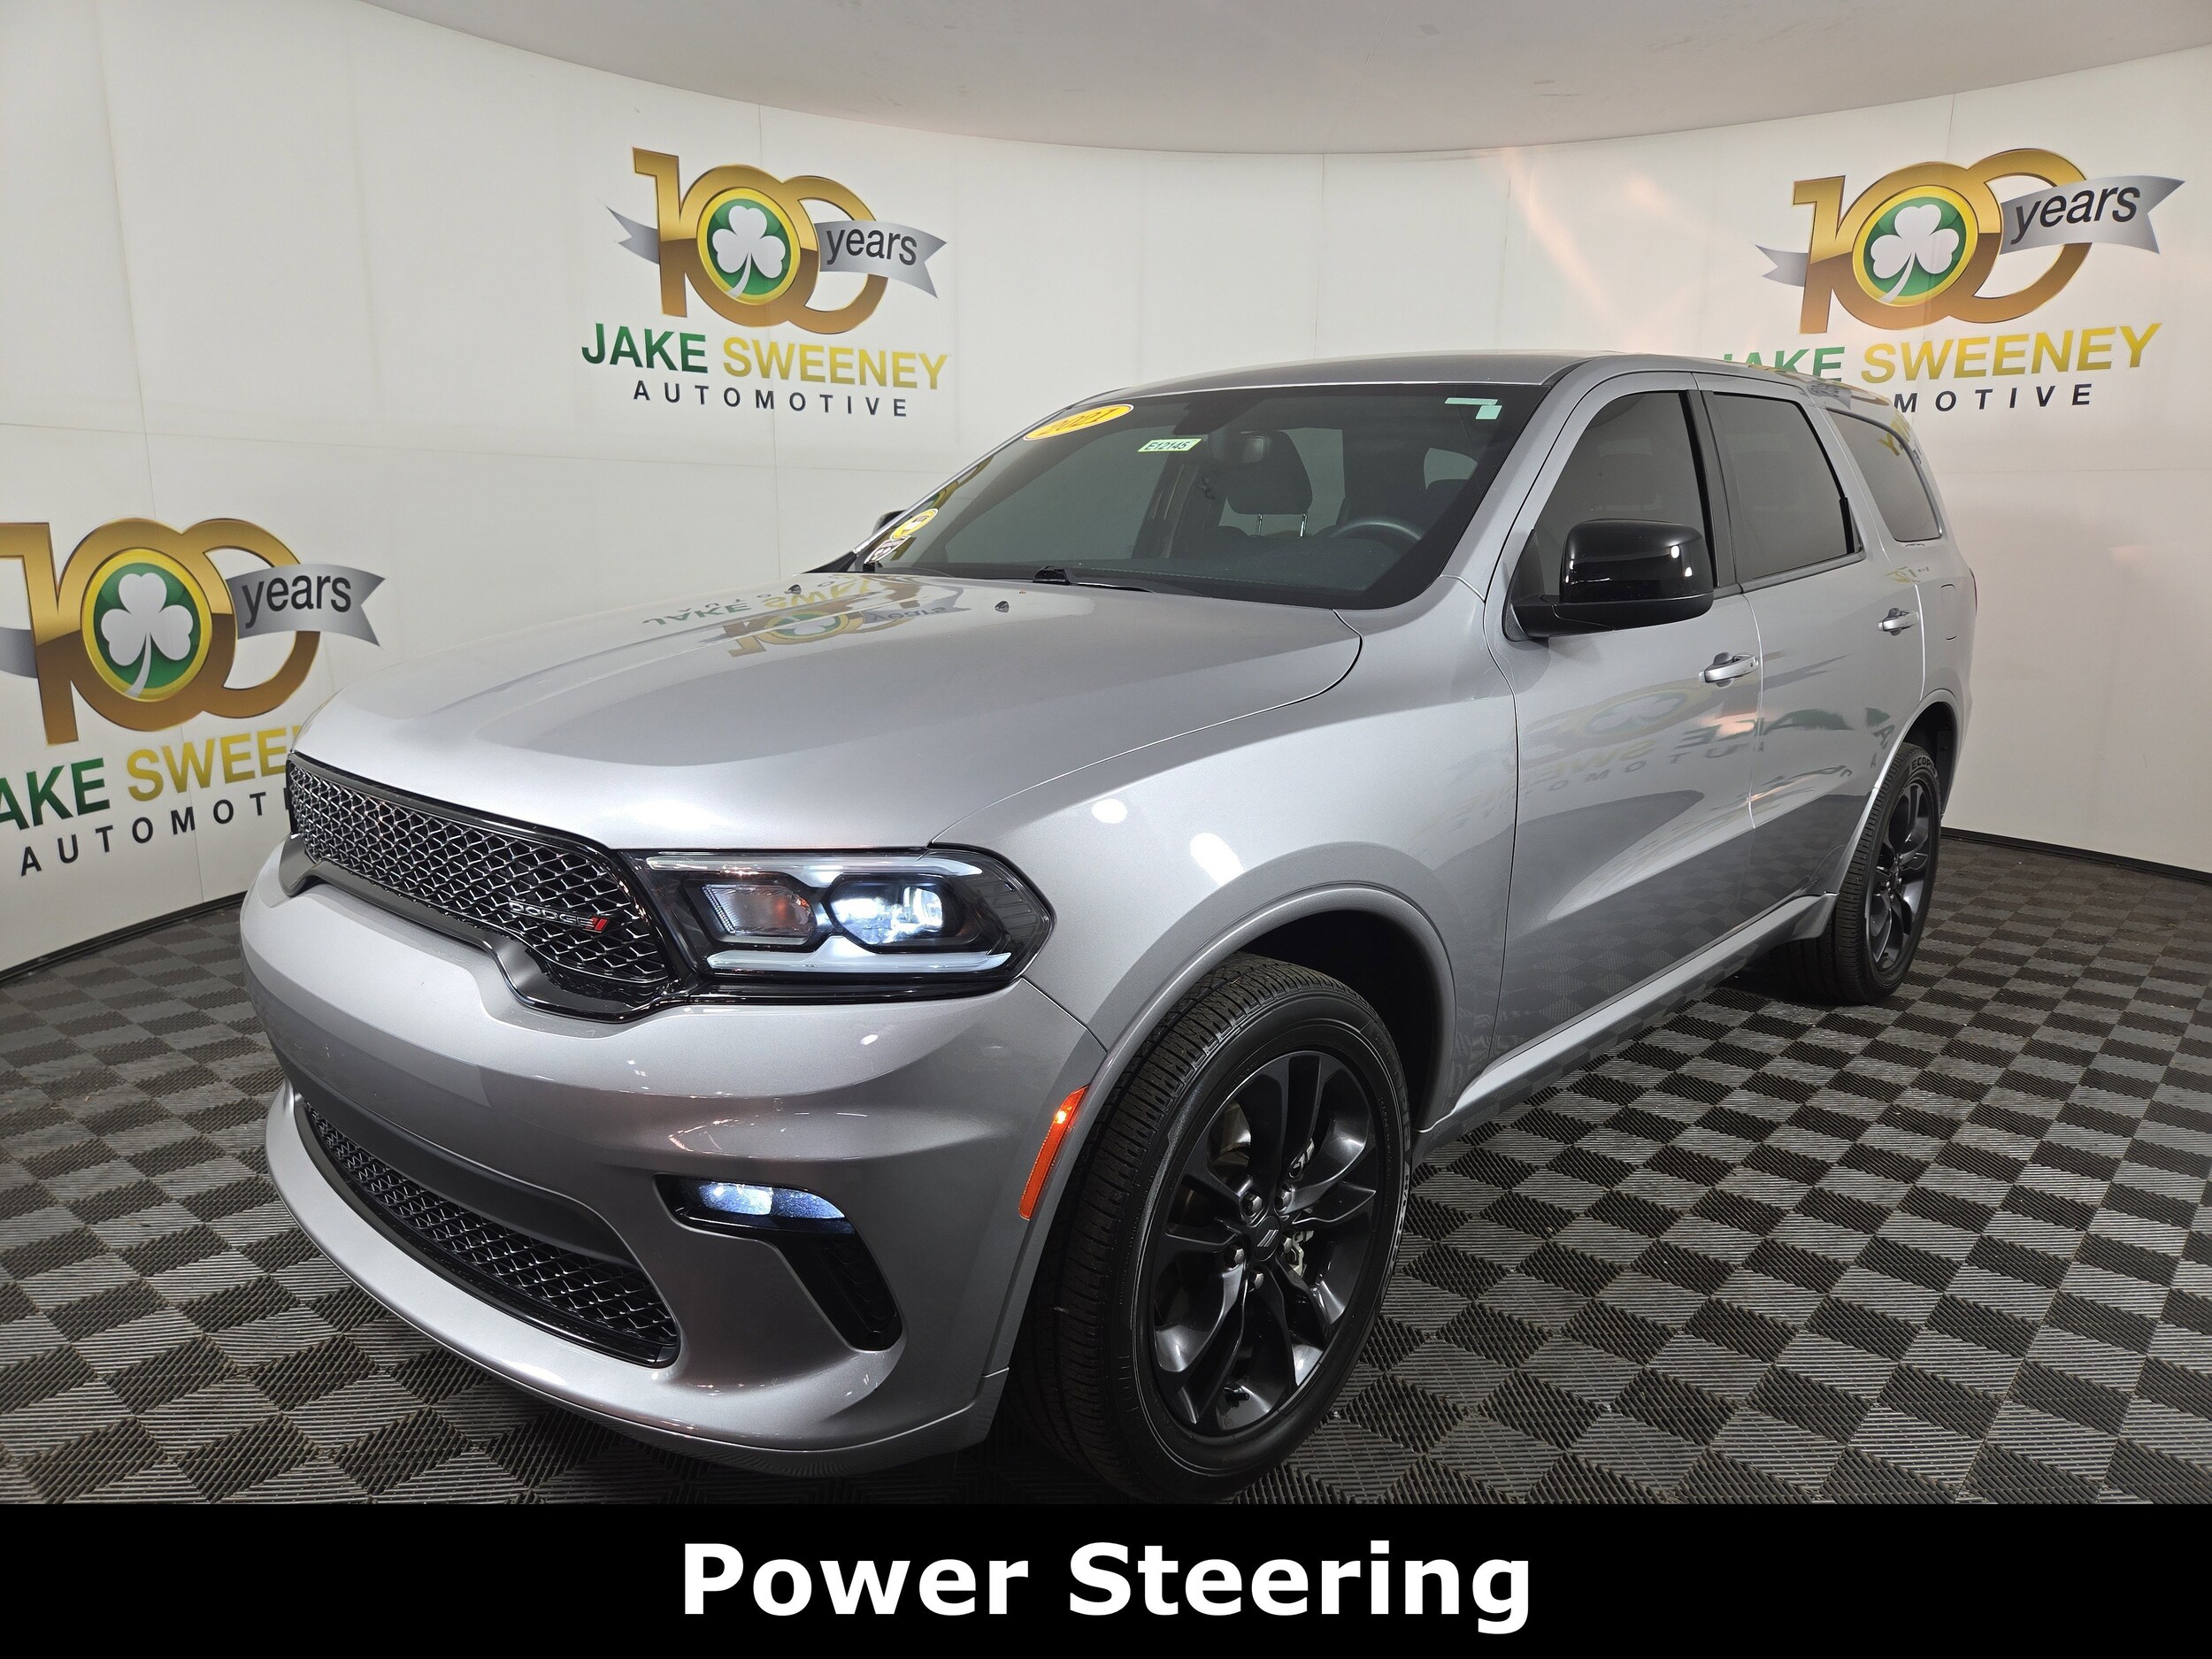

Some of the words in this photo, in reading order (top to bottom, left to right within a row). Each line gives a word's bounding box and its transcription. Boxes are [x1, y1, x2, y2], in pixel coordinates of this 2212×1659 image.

[632, 147, 888, 334] 100
[1793, 148, 2093, 334] 100
[2011, 186, 2140, 245] years
[826, 228, 918, 265] years
[581, 323, 709, 373] JAKE
[723, 336, 949, 390] SWEENEY
[1861, 322, 2162, 384] SWEENEY
[634, 380, 908, 418] AUTOMOTIVE
[1893, 383, 2093, 414] MOTIVE
[241, 574, 352, 629] years
[0, 757, 111, 831] AKE
[127, 726, 303, 802] SWEE
[509, 901, 595, 927] DODGE
